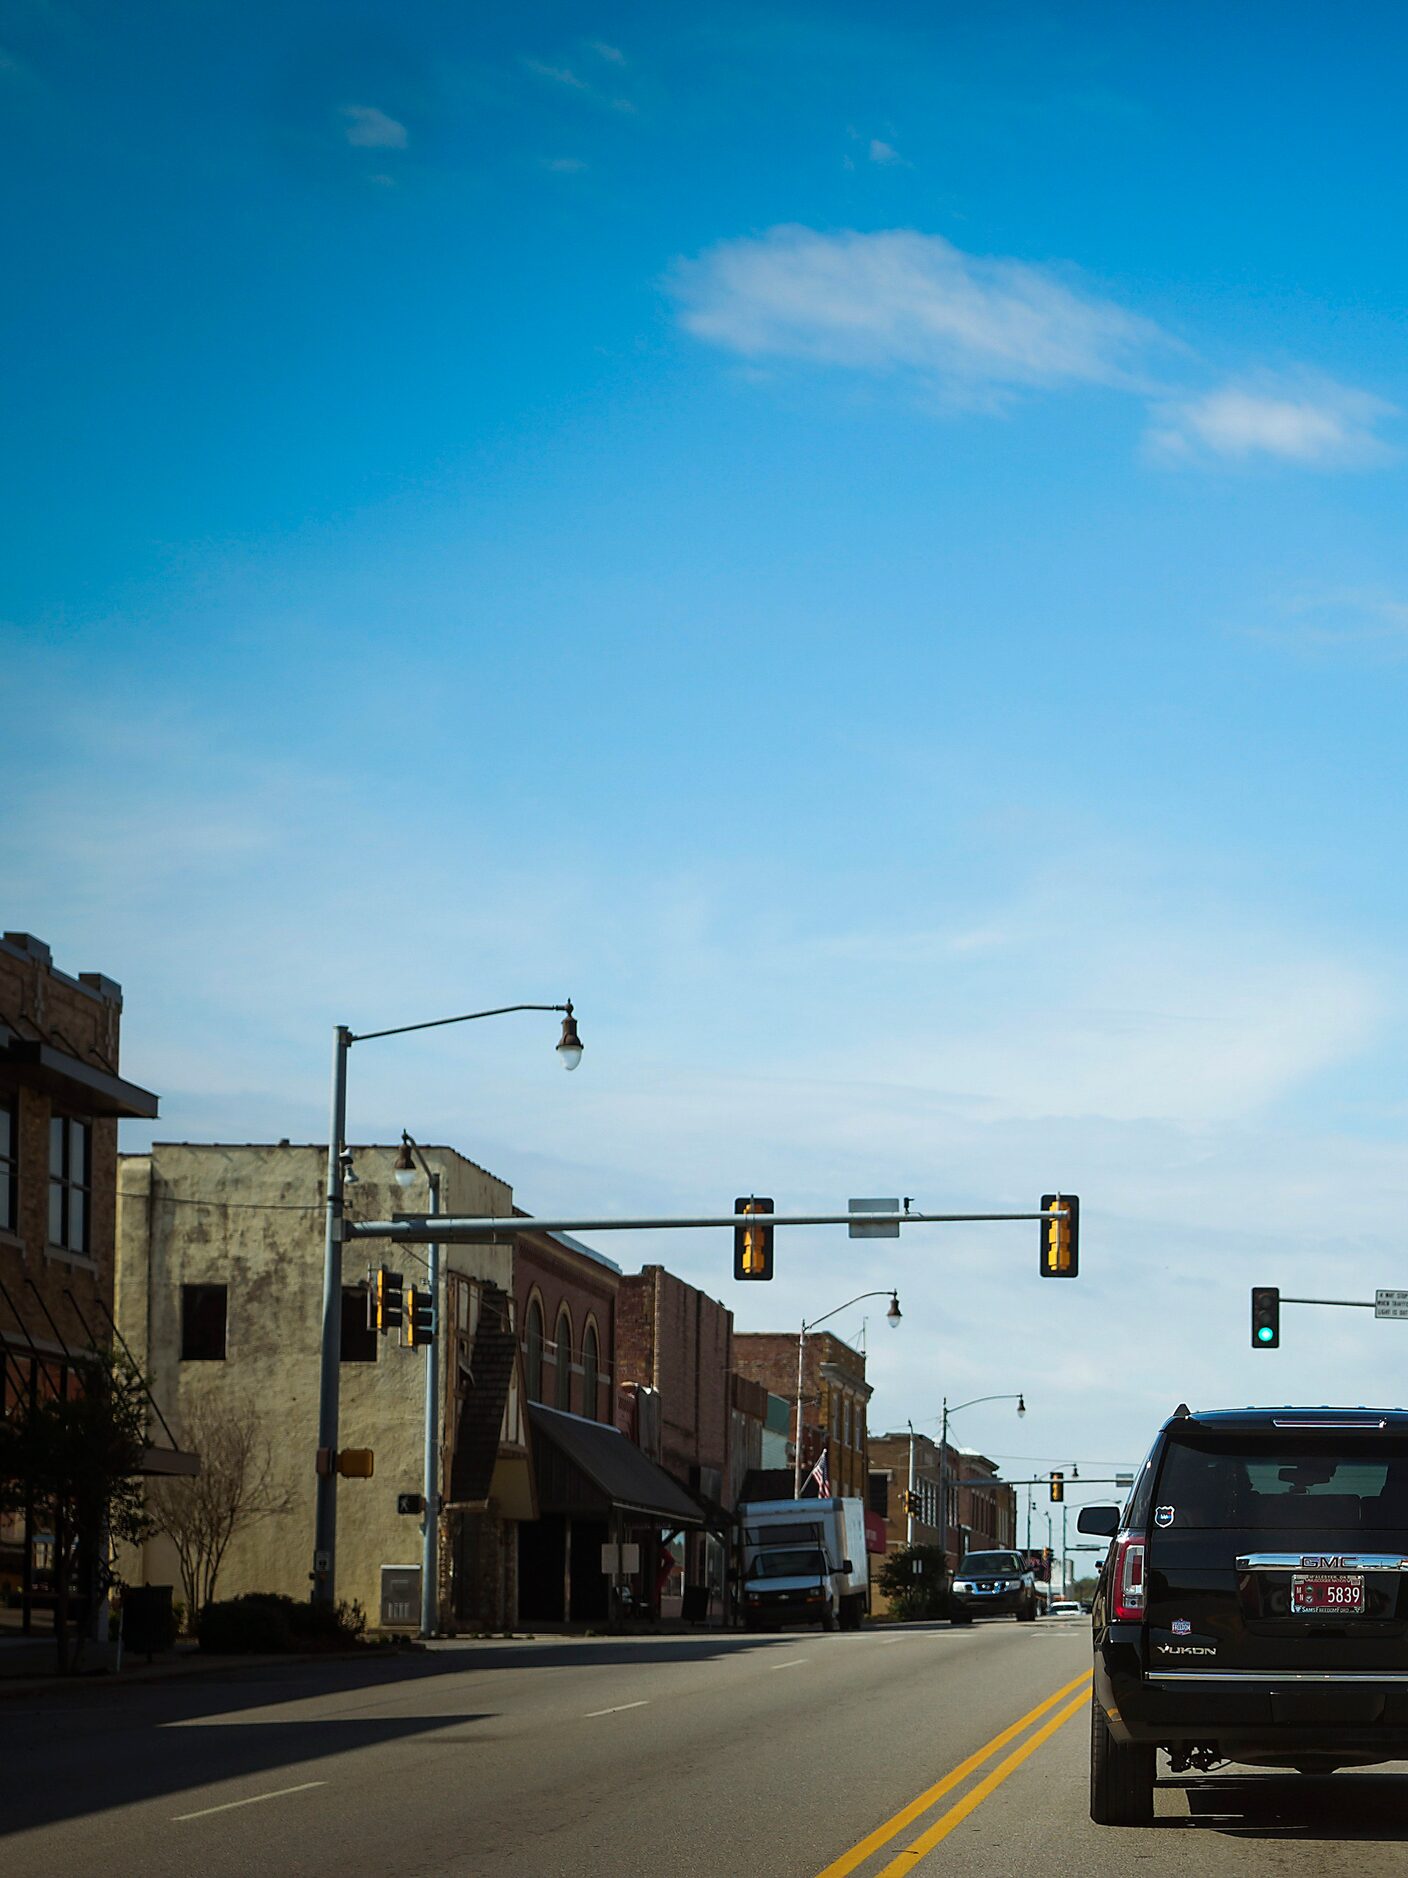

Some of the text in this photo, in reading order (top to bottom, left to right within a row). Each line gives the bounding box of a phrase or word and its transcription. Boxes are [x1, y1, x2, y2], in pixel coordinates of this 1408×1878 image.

[1301, 1556, 1359, 1568] GMC
[1327, 1586, 1360, 1603] 5839
[1157, 1645, 1217, 1655] YUKON
